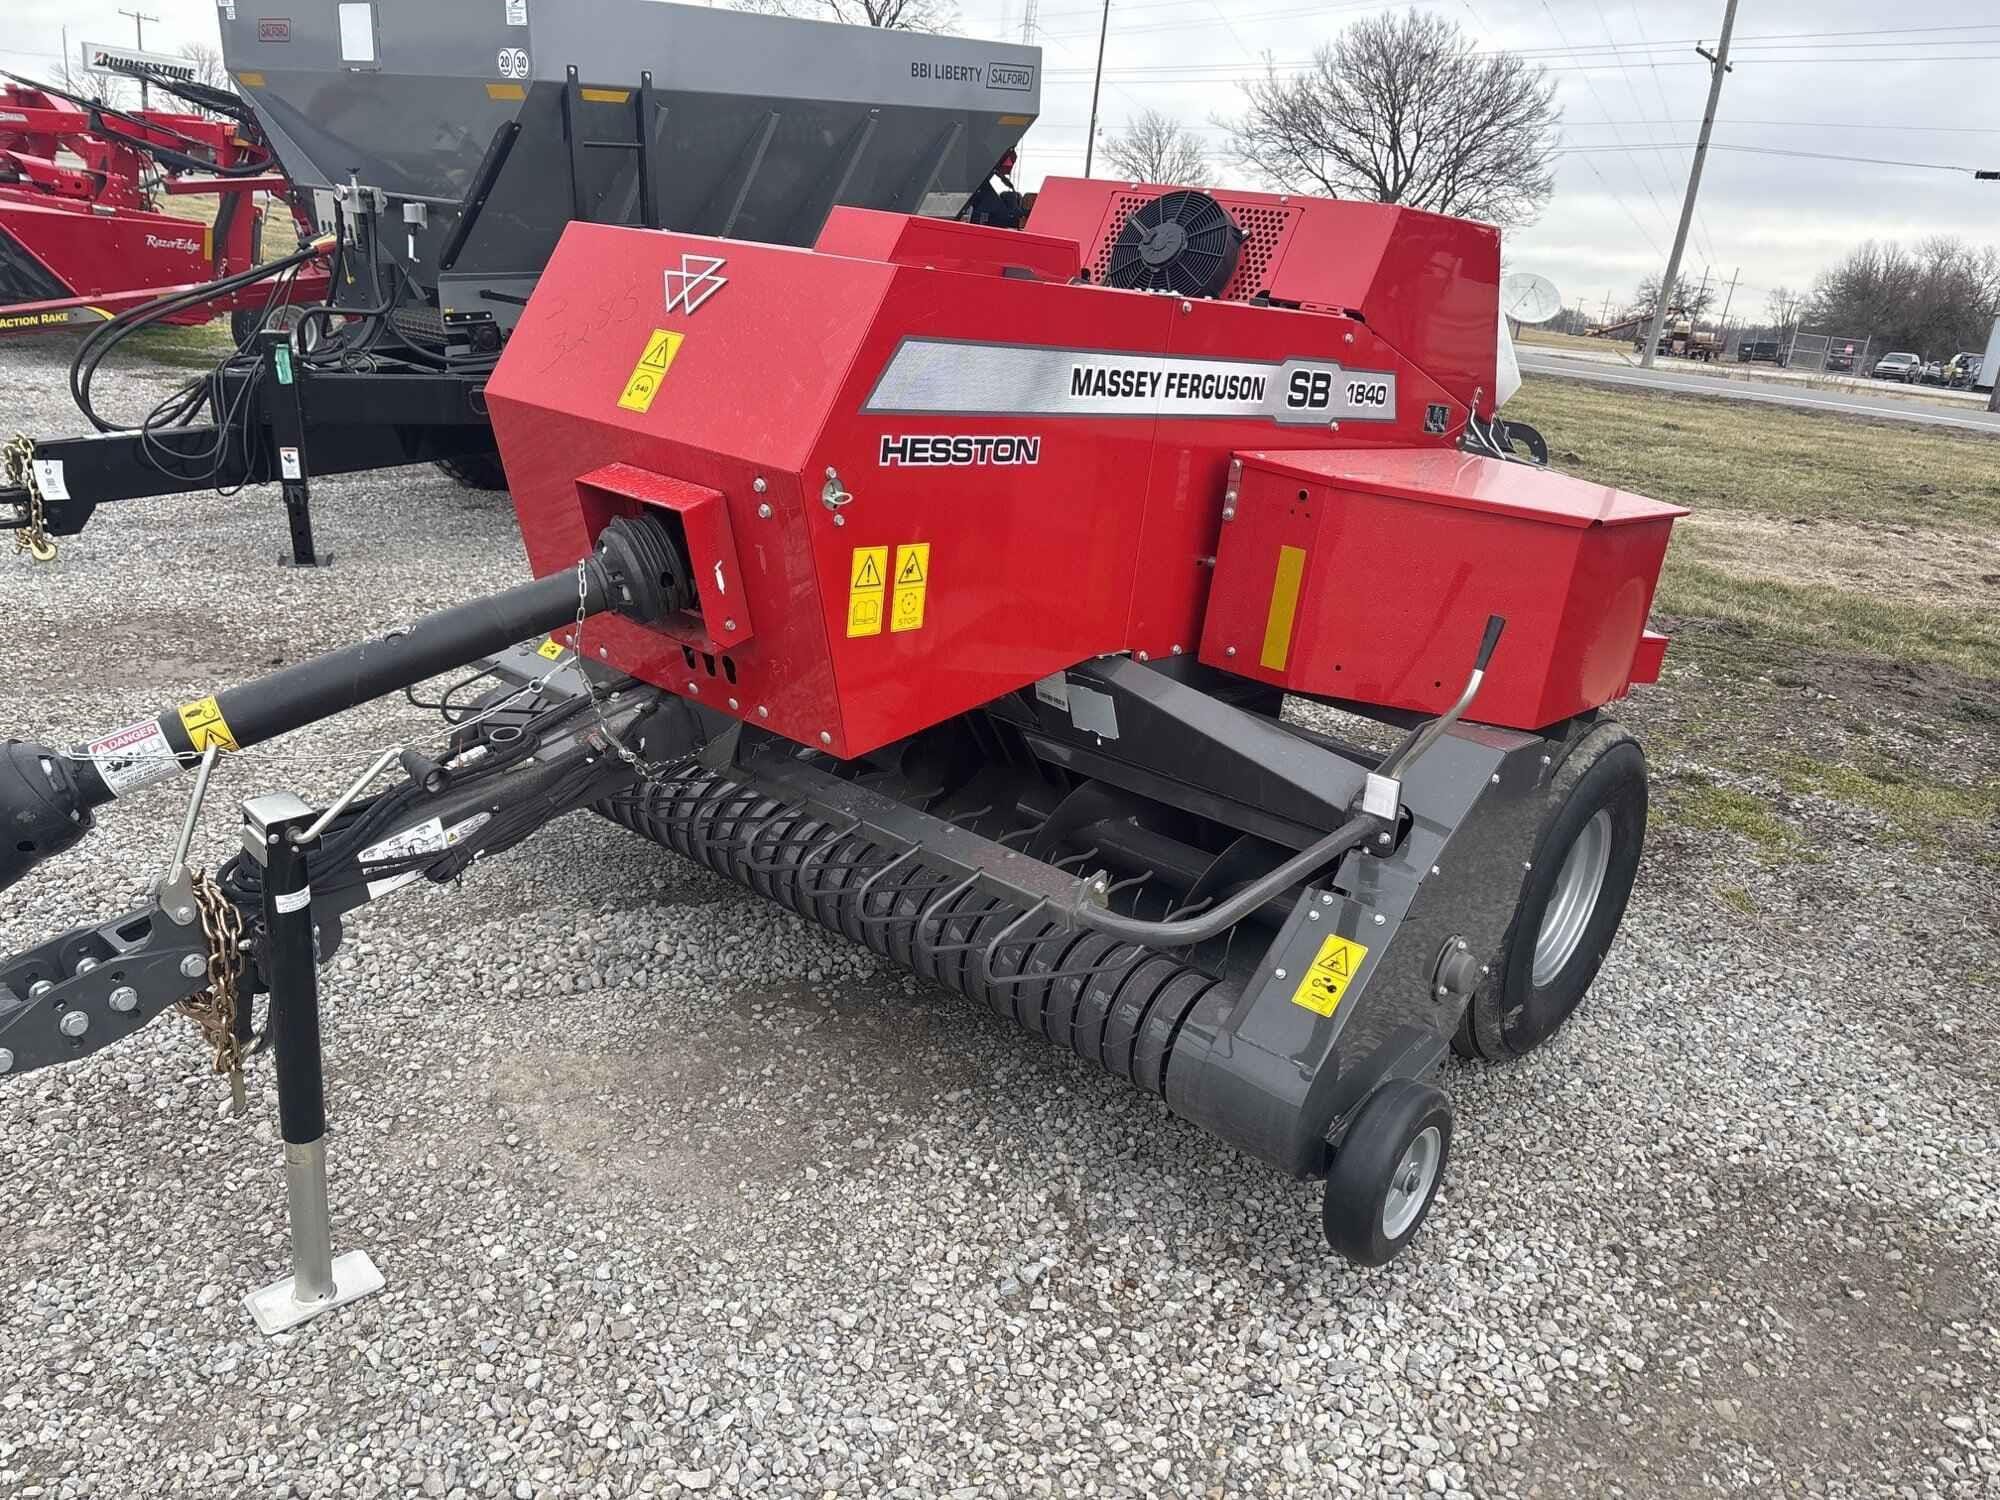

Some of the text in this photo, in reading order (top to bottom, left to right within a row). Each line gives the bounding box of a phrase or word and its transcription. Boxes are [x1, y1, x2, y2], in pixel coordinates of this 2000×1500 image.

[93, 51, 196, 80] BRIDGESTONE
[500, 55, 510, 68] 20
[516, 56, 527, 69] 30
[911, 62, 983, 83] BBI LIBERTY
[991, 68, 1030, 86] SALFORD
[145, 234, 200, 255] RazorEdge
[0, 312, 69, 329] ACTION RAKE
[1071, 367, 1387, 408] MASSEY FERGUSON SB 1840
[879, 435, 1041, 467] HESSTON
[108, 725, 157, 750] DANGER
